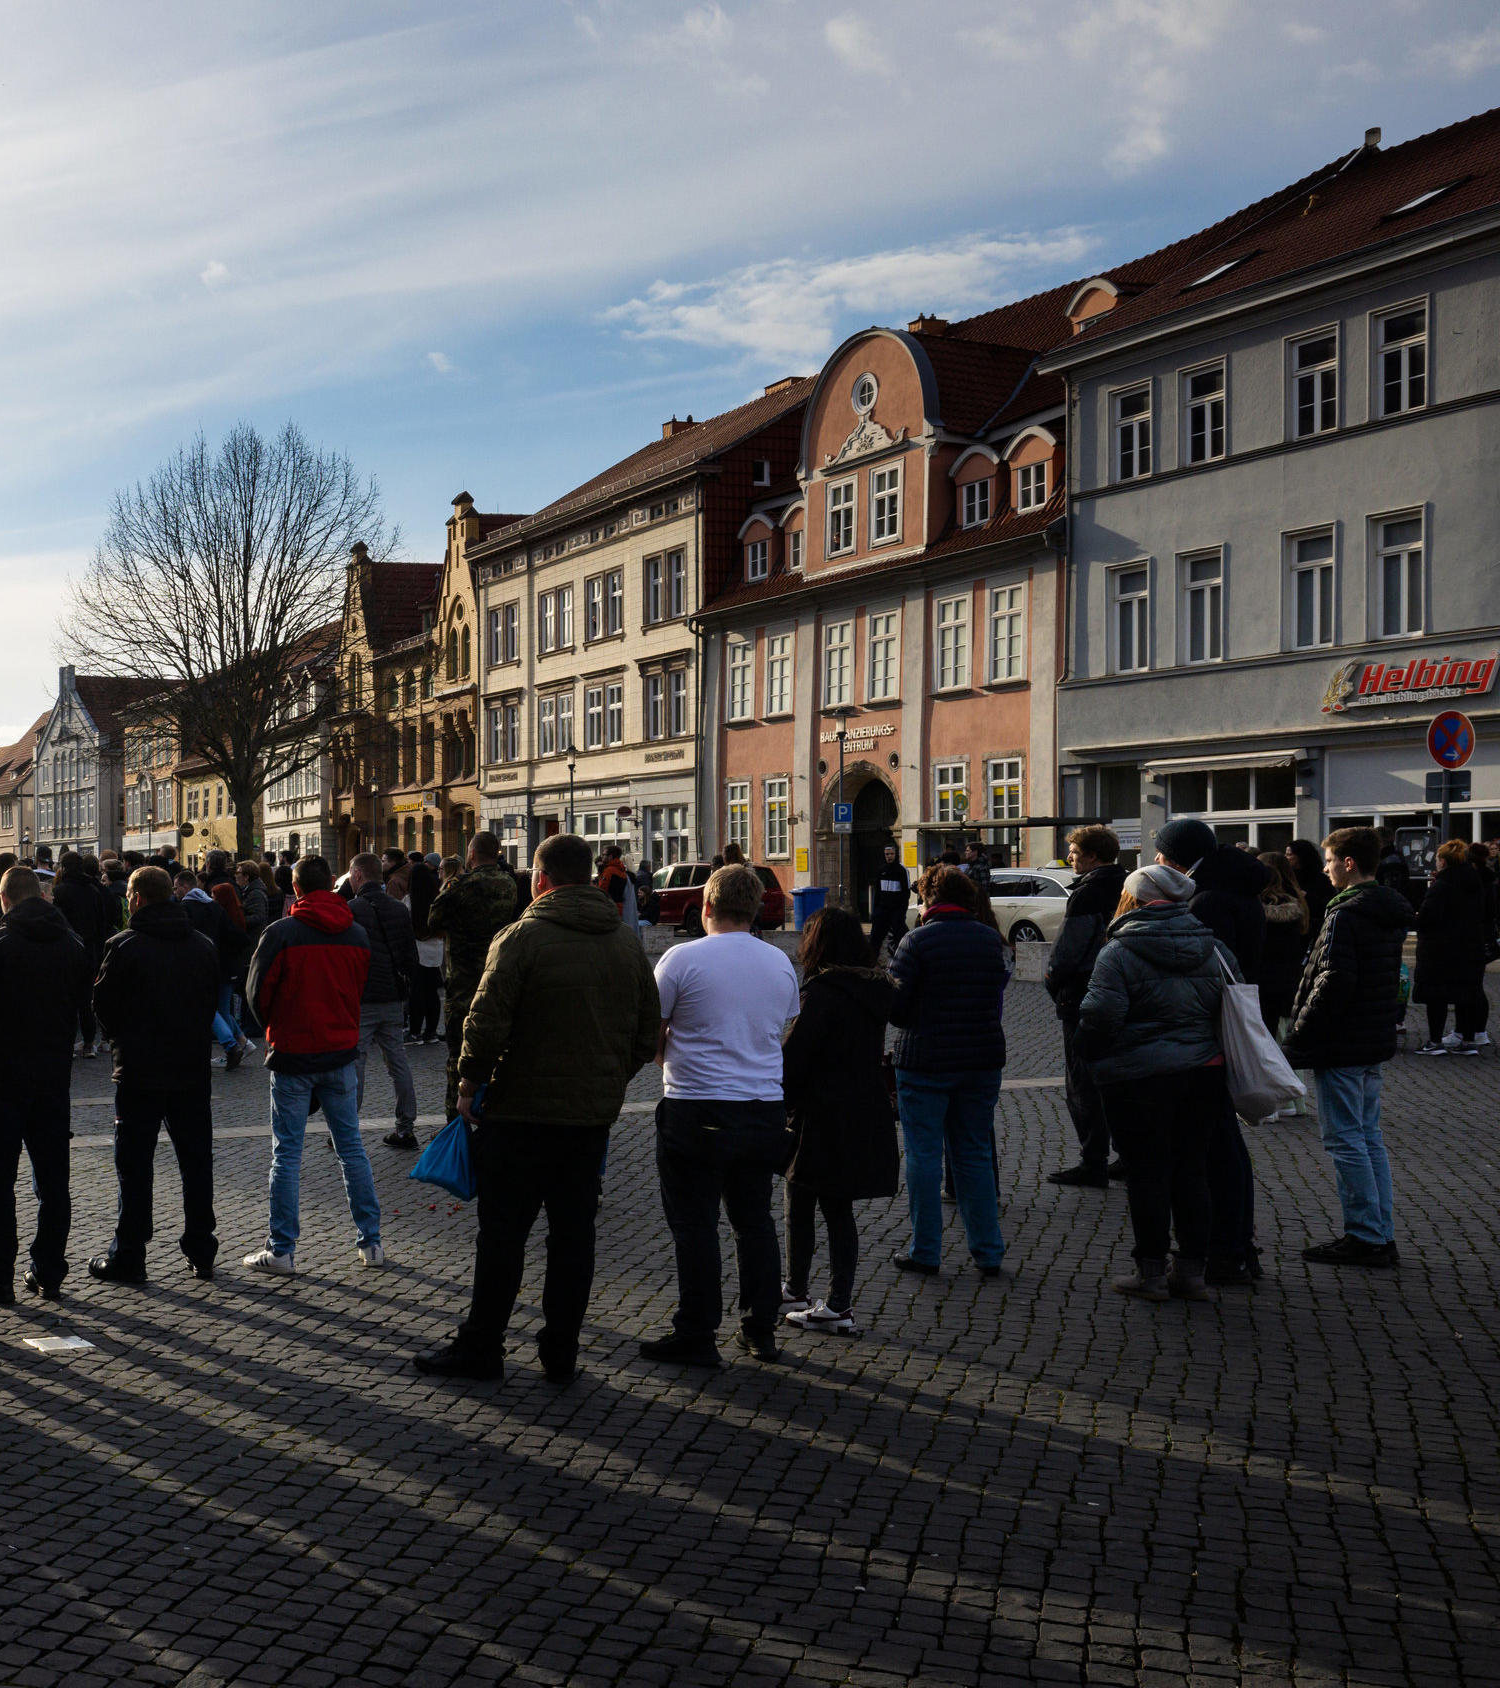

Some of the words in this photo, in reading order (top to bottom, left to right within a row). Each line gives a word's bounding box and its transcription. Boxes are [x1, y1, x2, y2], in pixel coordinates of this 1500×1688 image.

[1358, 656, 1496, 695] Helbing
[1359, 695, 1381, 704] mein
[842, 739, 874, 753] ENTRUM
[838, 806, 848, 820] P
